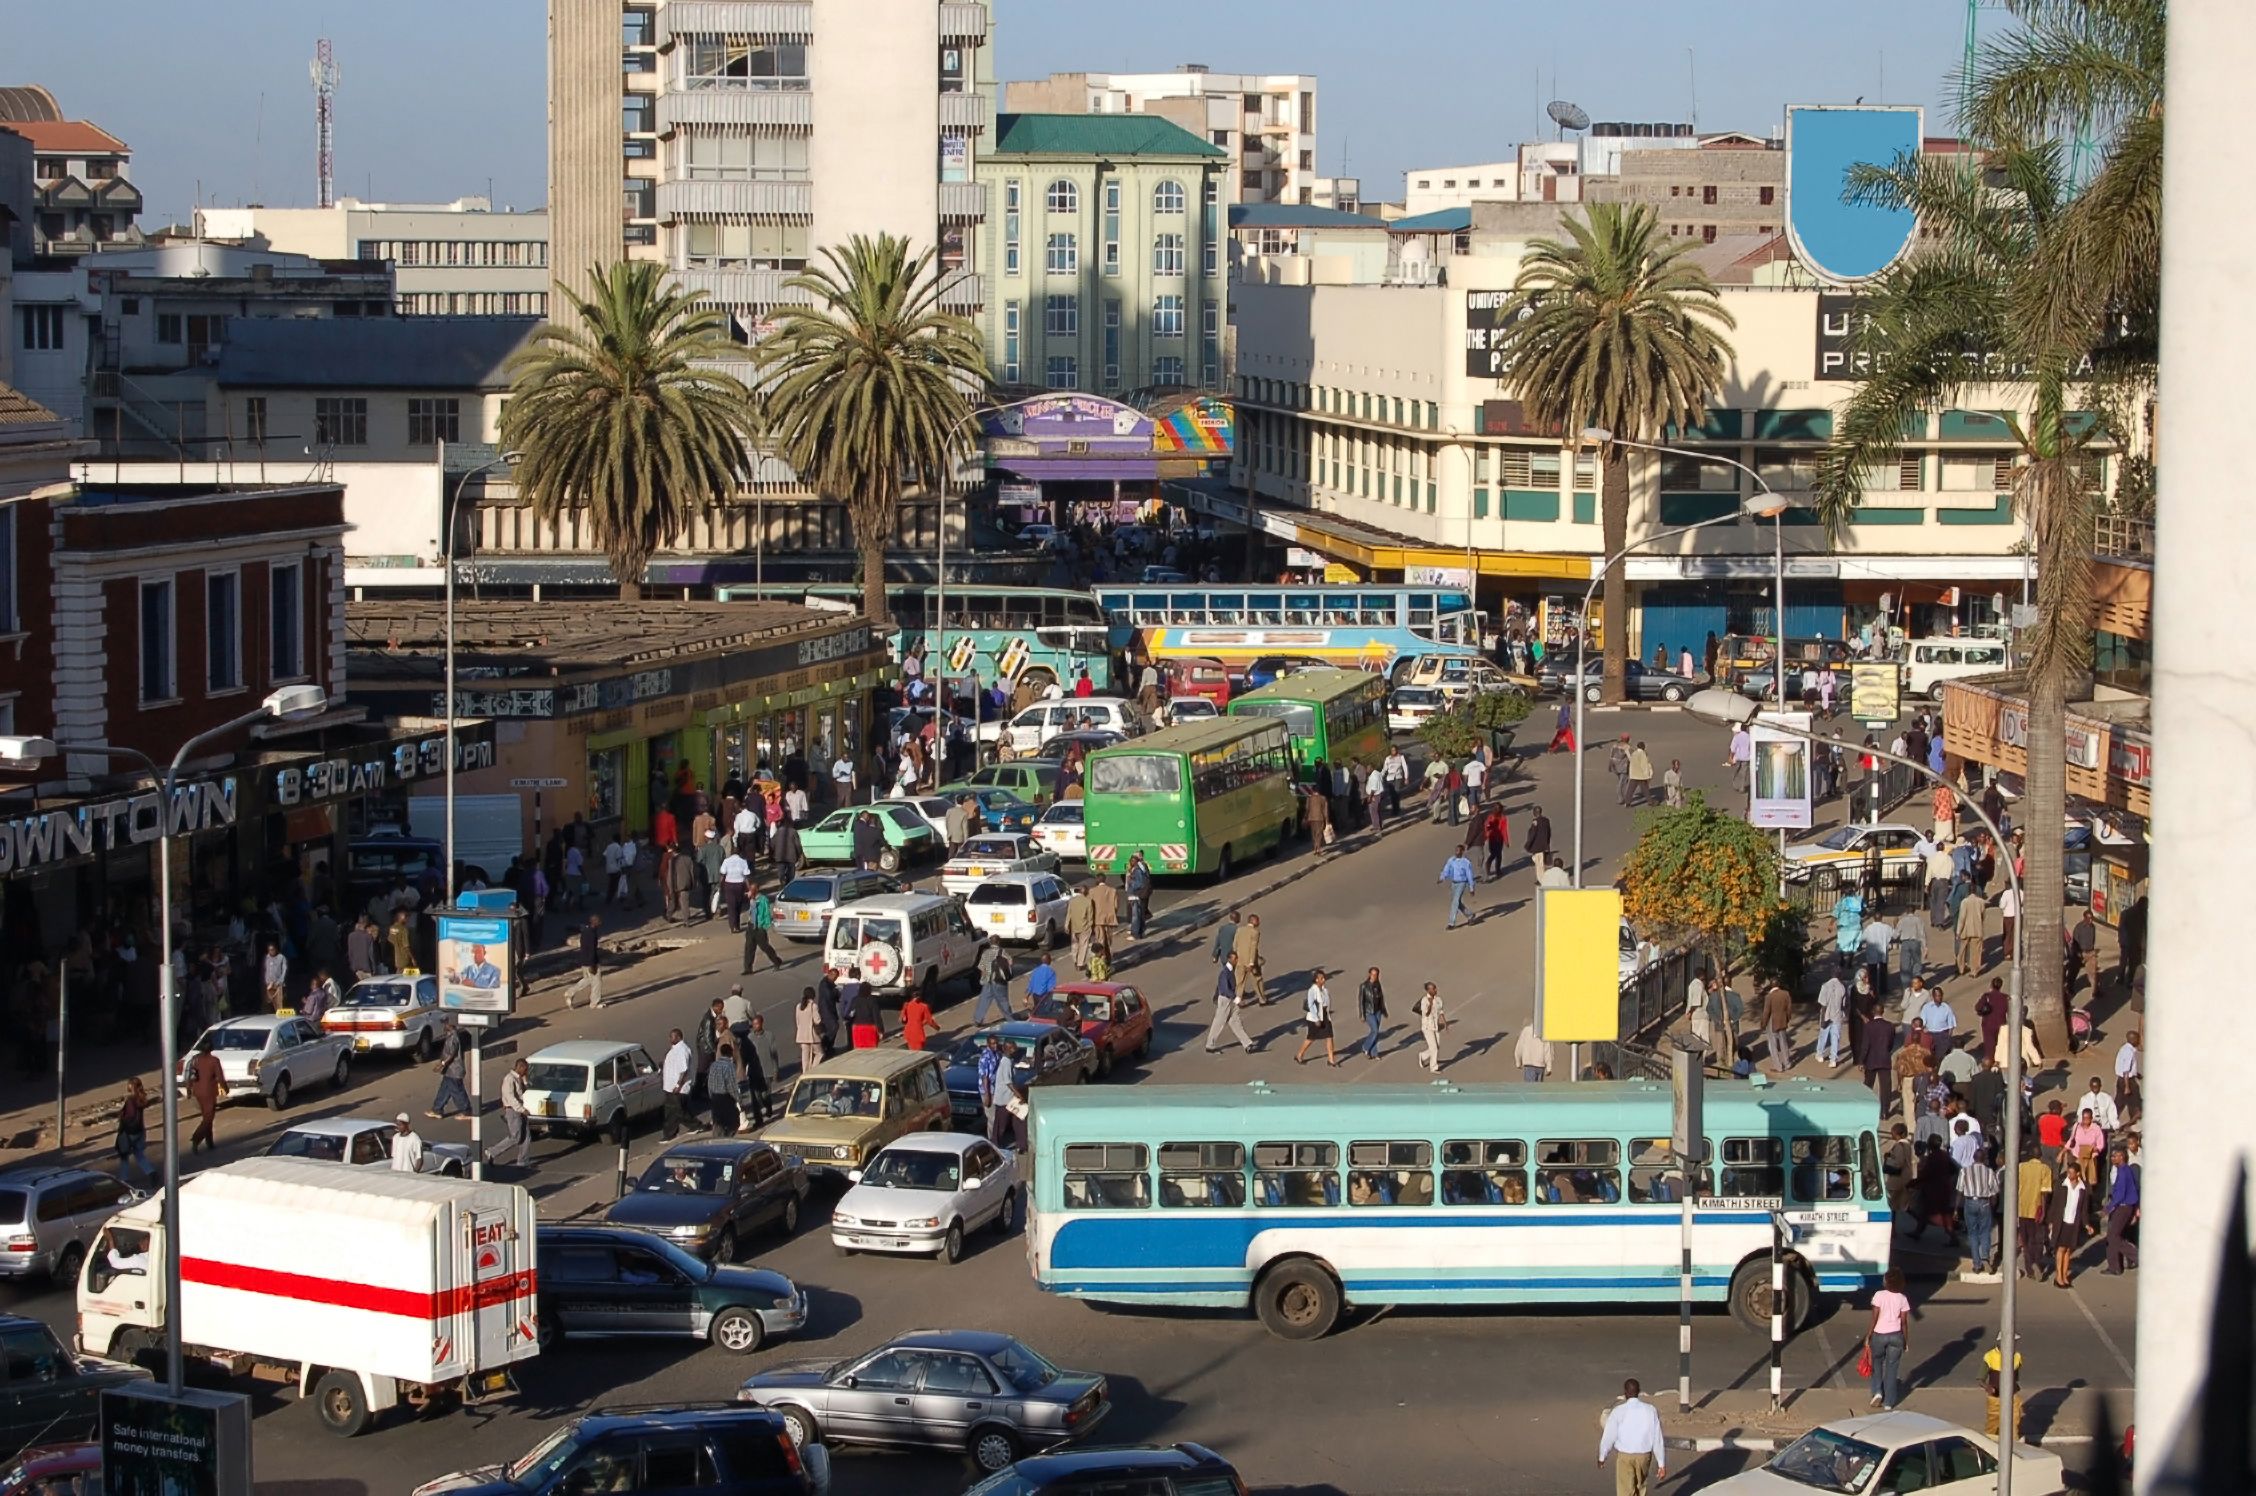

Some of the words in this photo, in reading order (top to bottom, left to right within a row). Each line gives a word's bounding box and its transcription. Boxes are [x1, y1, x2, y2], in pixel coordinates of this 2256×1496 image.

[1466, 328, 1487, 350] THE
[1701, 1198, 1742, 1209] KIMATHI
[1744, 1198, 1781, 1208] STREET
[1799, 1212, 1825, 1222] KIMATHI
[1827, 1212, 1849, 1222] STREET
[113, 1423, 137, 1438] Safe
[113, 1441, 149, 1457] money
[151, 1445, 202, 1463] transfers.
